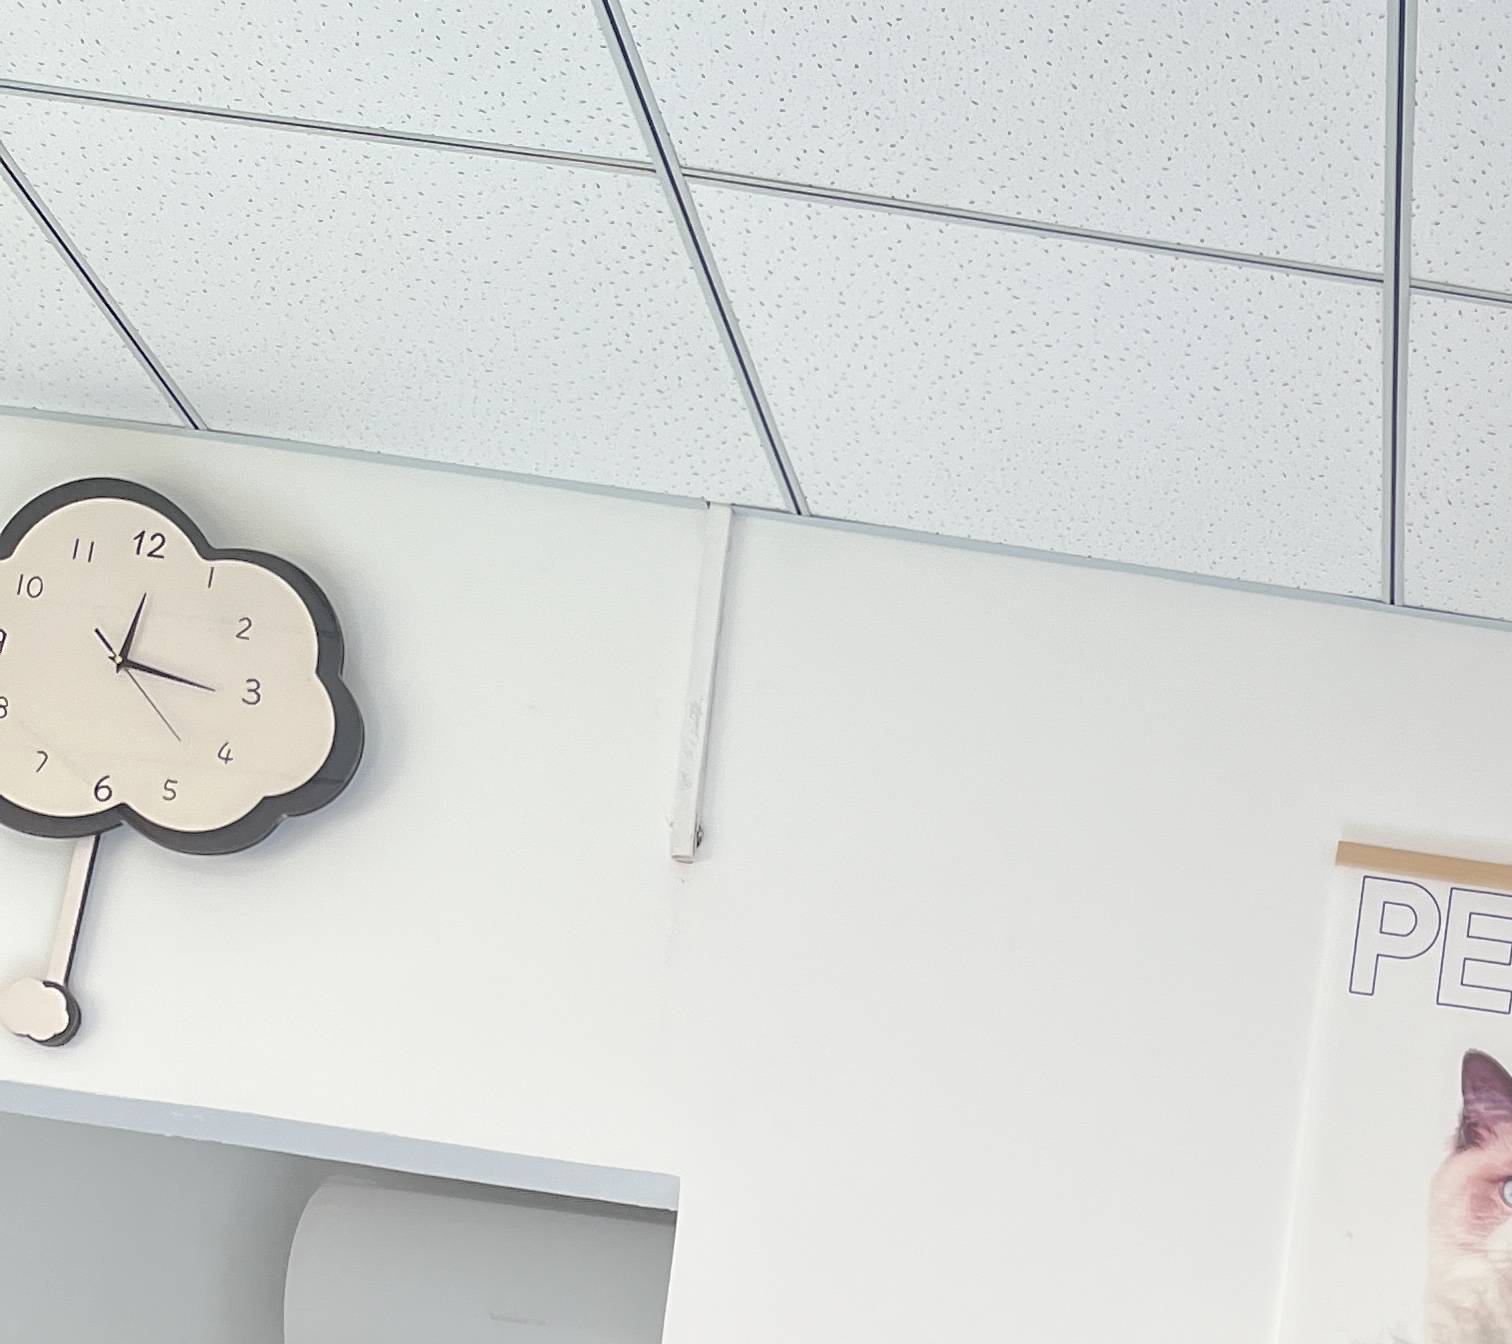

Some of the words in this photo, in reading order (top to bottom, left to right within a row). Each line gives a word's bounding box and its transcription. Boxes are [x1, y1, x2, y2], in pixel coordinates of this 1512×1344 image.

[72, 538, 94, 563] 11
[133, 530, 166, 559] 12
[16, 574, 44, 598] 10
[208, 566, 214, 588] 1
[235, 617, 252, 640] 2
[241, 678, 262, 705] 3
[36, 751, 48, 773] 7
[217, 742, 234, 764] 4
[94, 775, 112, 802] 6
[162, 779, 178, 801] 5
